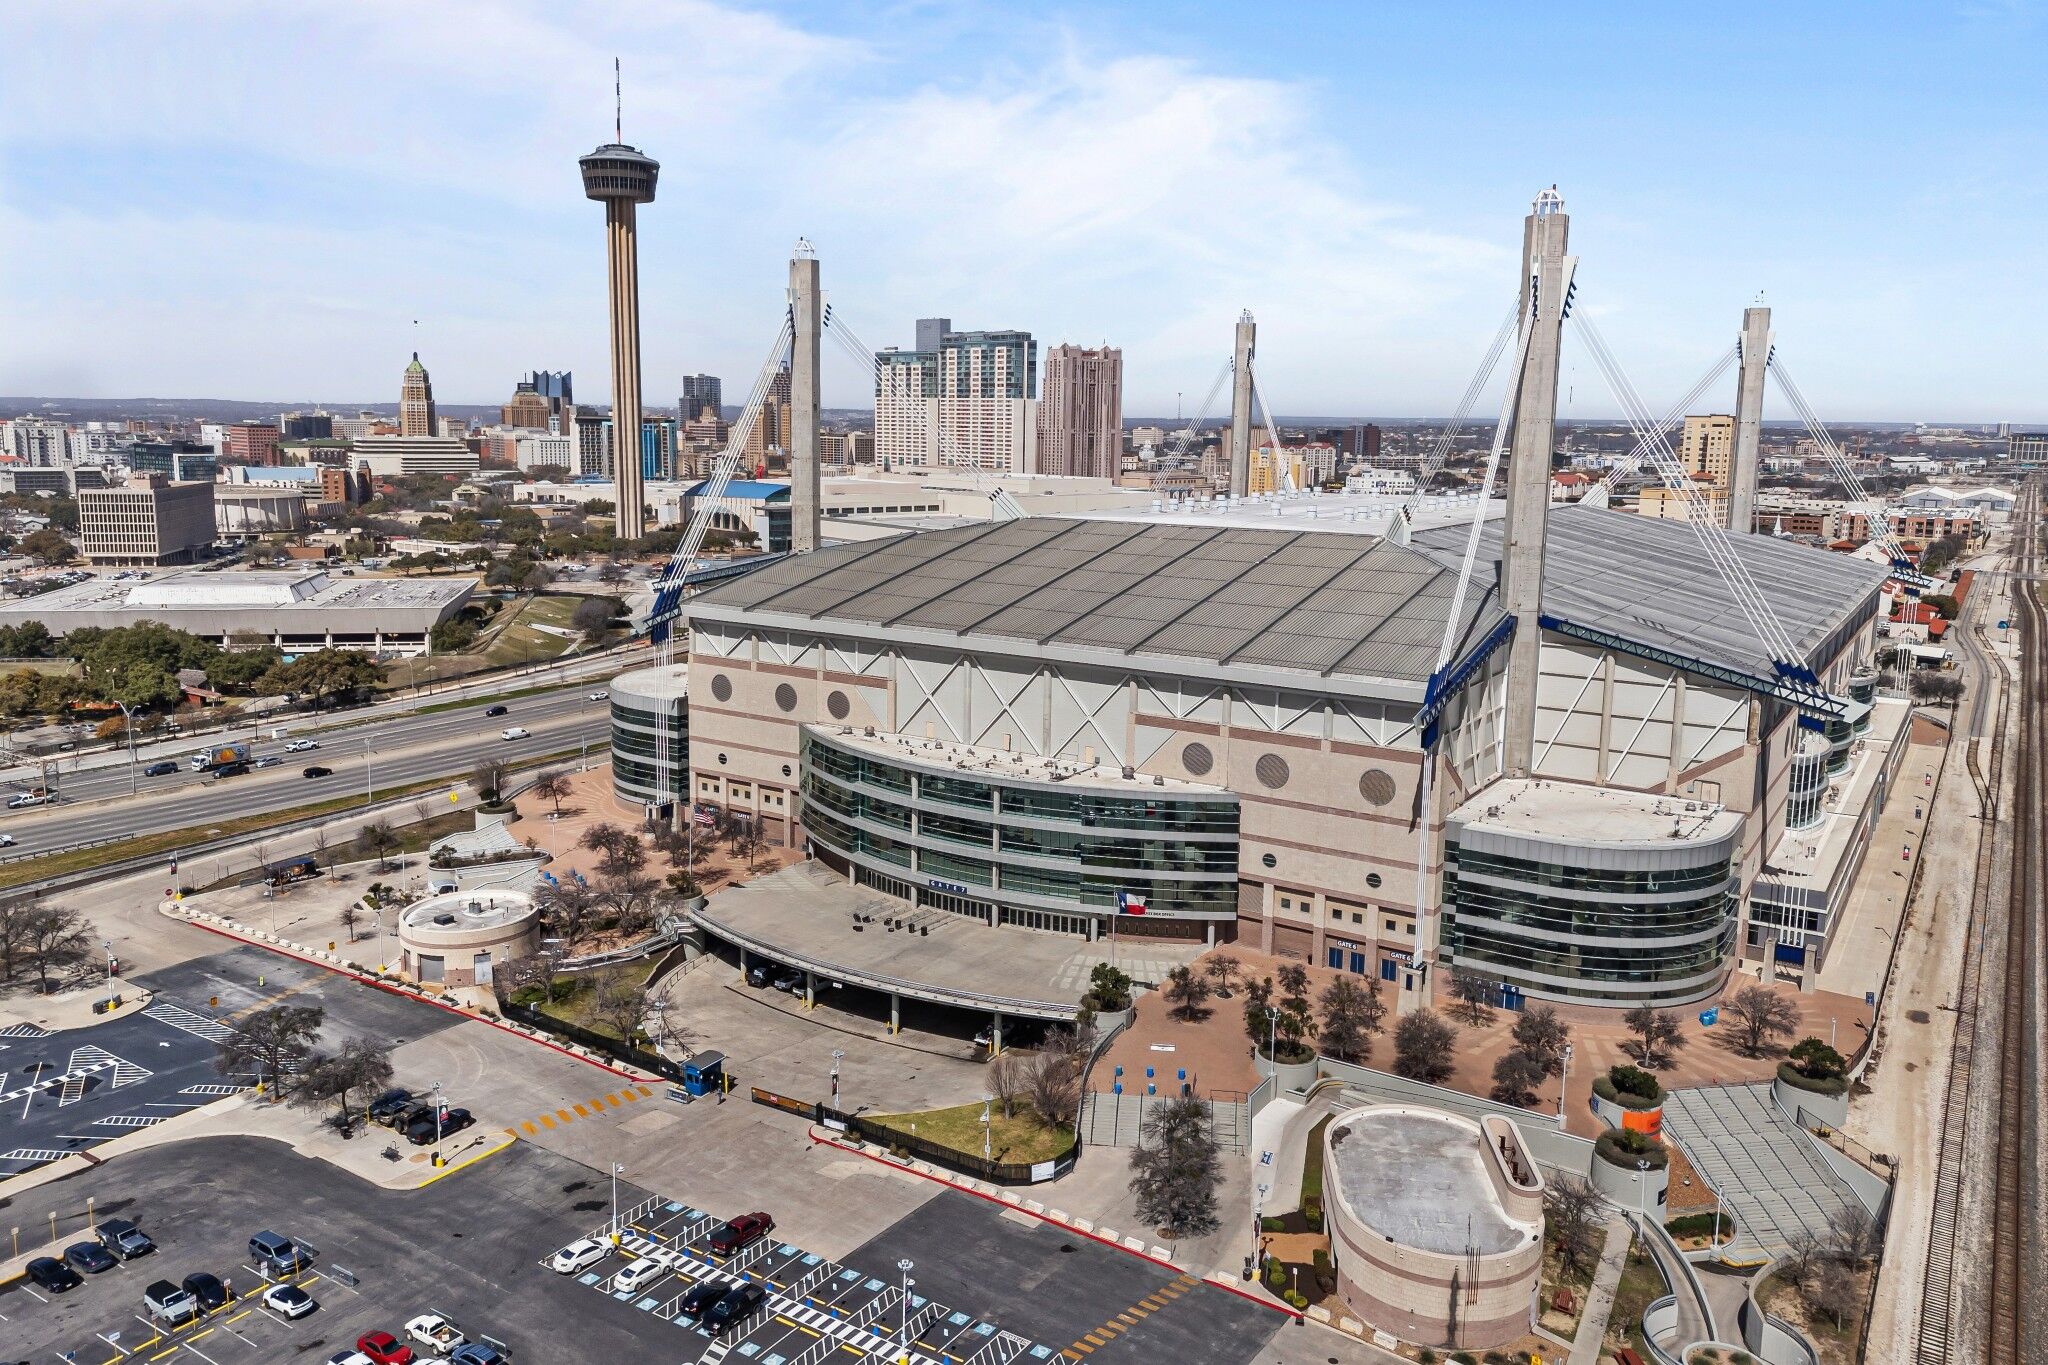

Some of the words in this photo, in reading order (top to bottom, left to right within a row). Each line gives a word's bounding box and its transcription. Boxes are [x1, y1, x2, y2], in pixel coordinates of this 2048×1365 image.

[930, 880, 957, 890] GATE
[1337, 940, 1352, 949] GATE
[1390, 952, 1405, 960] GATE
